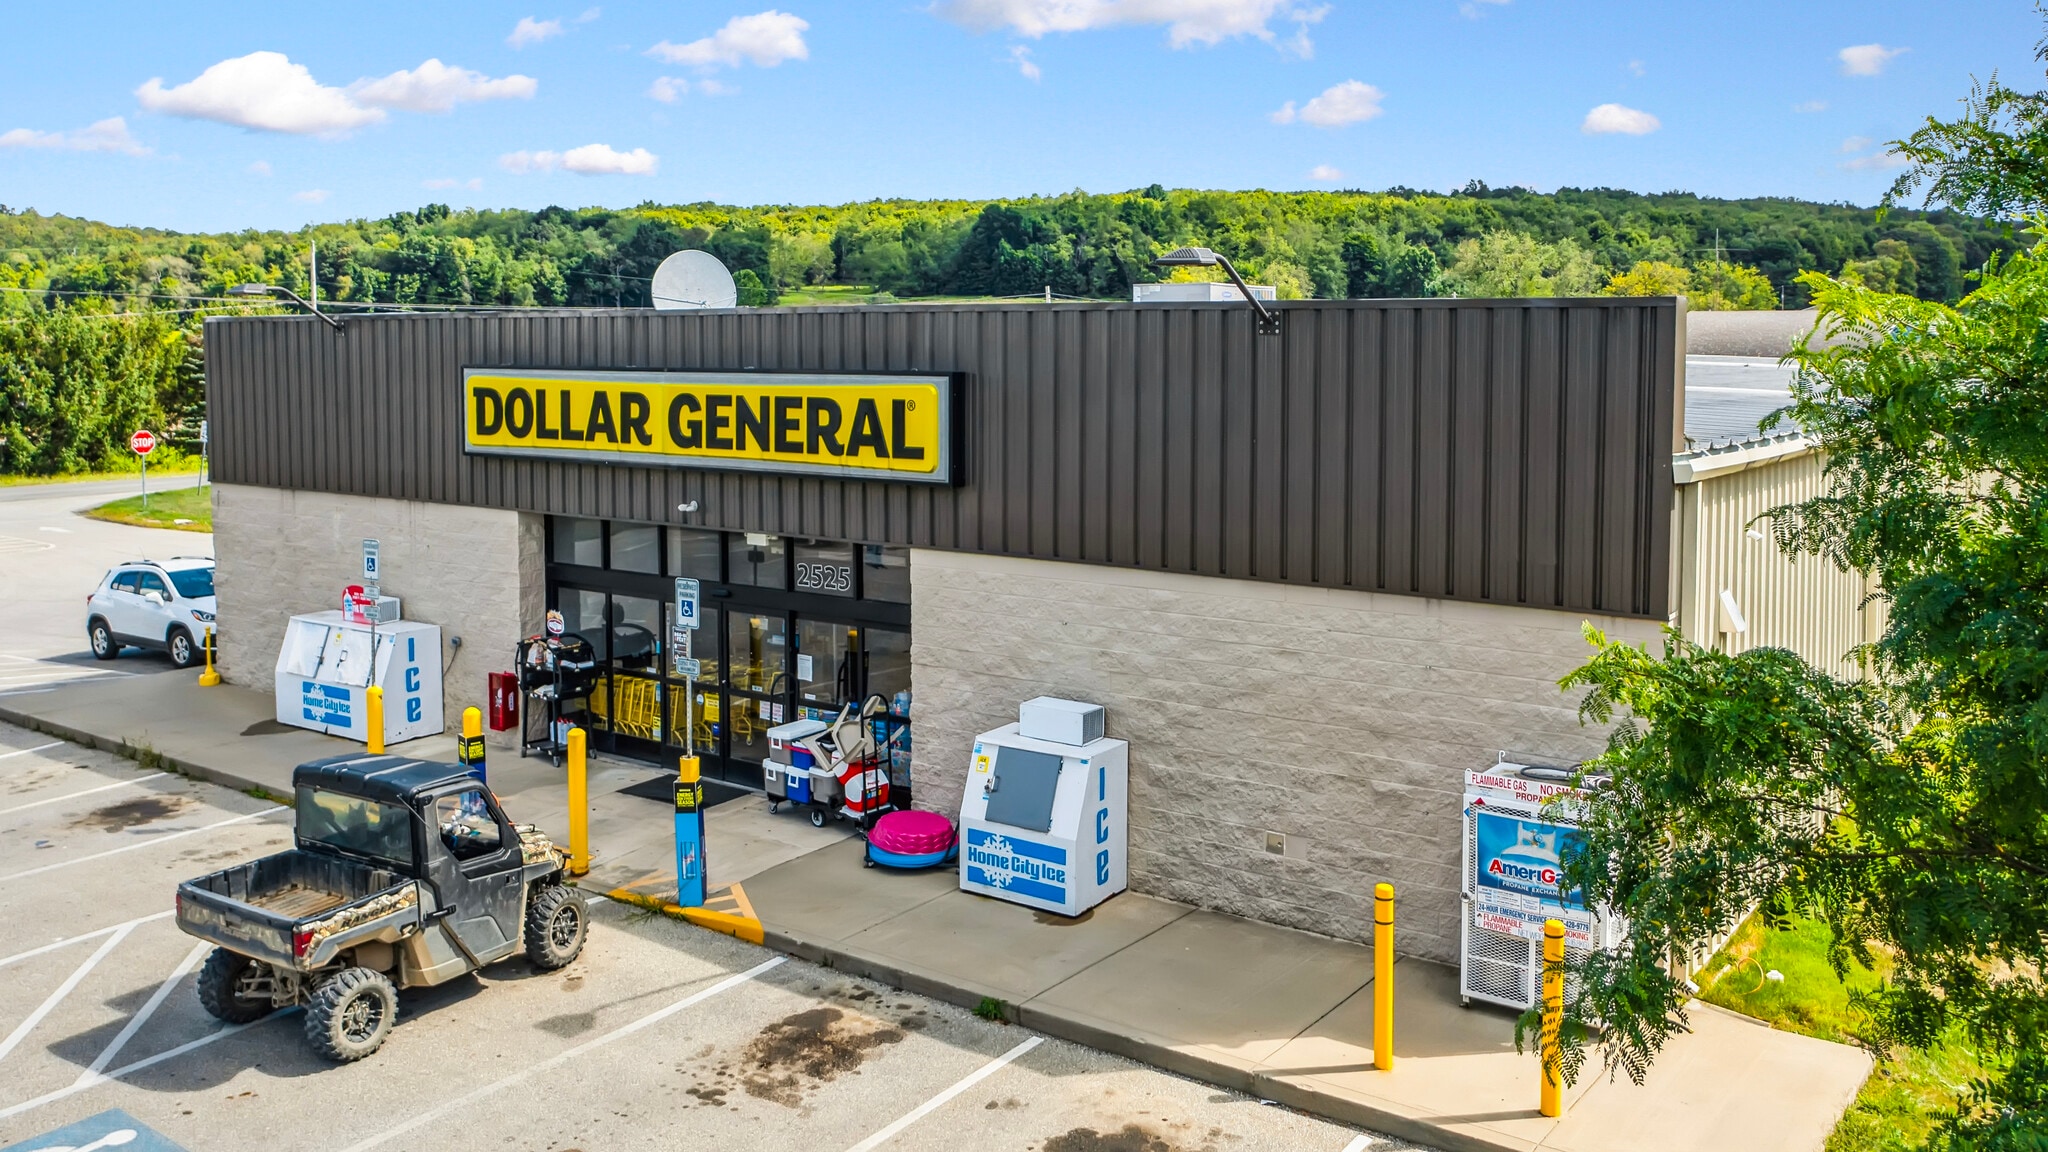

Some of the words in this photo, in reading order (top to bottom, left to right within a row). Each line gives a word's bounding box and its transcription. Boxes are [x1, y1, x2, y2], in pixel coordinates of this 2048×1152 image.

[473, 386, 653, 446] DOLLAR
[668, 392, 925, 460] GENERAL
[133, 437, 153, 448] STOP
[796, 562, 851, 591] 2525
[303, 694, 324, 708] Home
[324, 698, 339, 714] City
[338, 701, 351, 714] Ice
[1471, 773, 1512, 790] FLAMMABLE
[1512, 779, 1528, 792] GAS
[1540, 784, 1553, 796] NO
[1515, 792, 1543, 803] PROPA
[968, 846, 1009, 871] Home
[1011, 856, 1040, 881] City
[1042, 863, 1066, 883] Ice
[1489, 859, 1563, 884] AmeriGa
[1502, 880, 1529, 892] PROPANE
[1478, 903, 1499, 914] 24-HOUR
[1499, 908, 1526, 920] EMERGENCY
[1483, 913, 1523, 929] FLAMMABLE
[1483, 921, 1512, 933] PROPANE
[1564, 930, 1589, 941] MOKING
